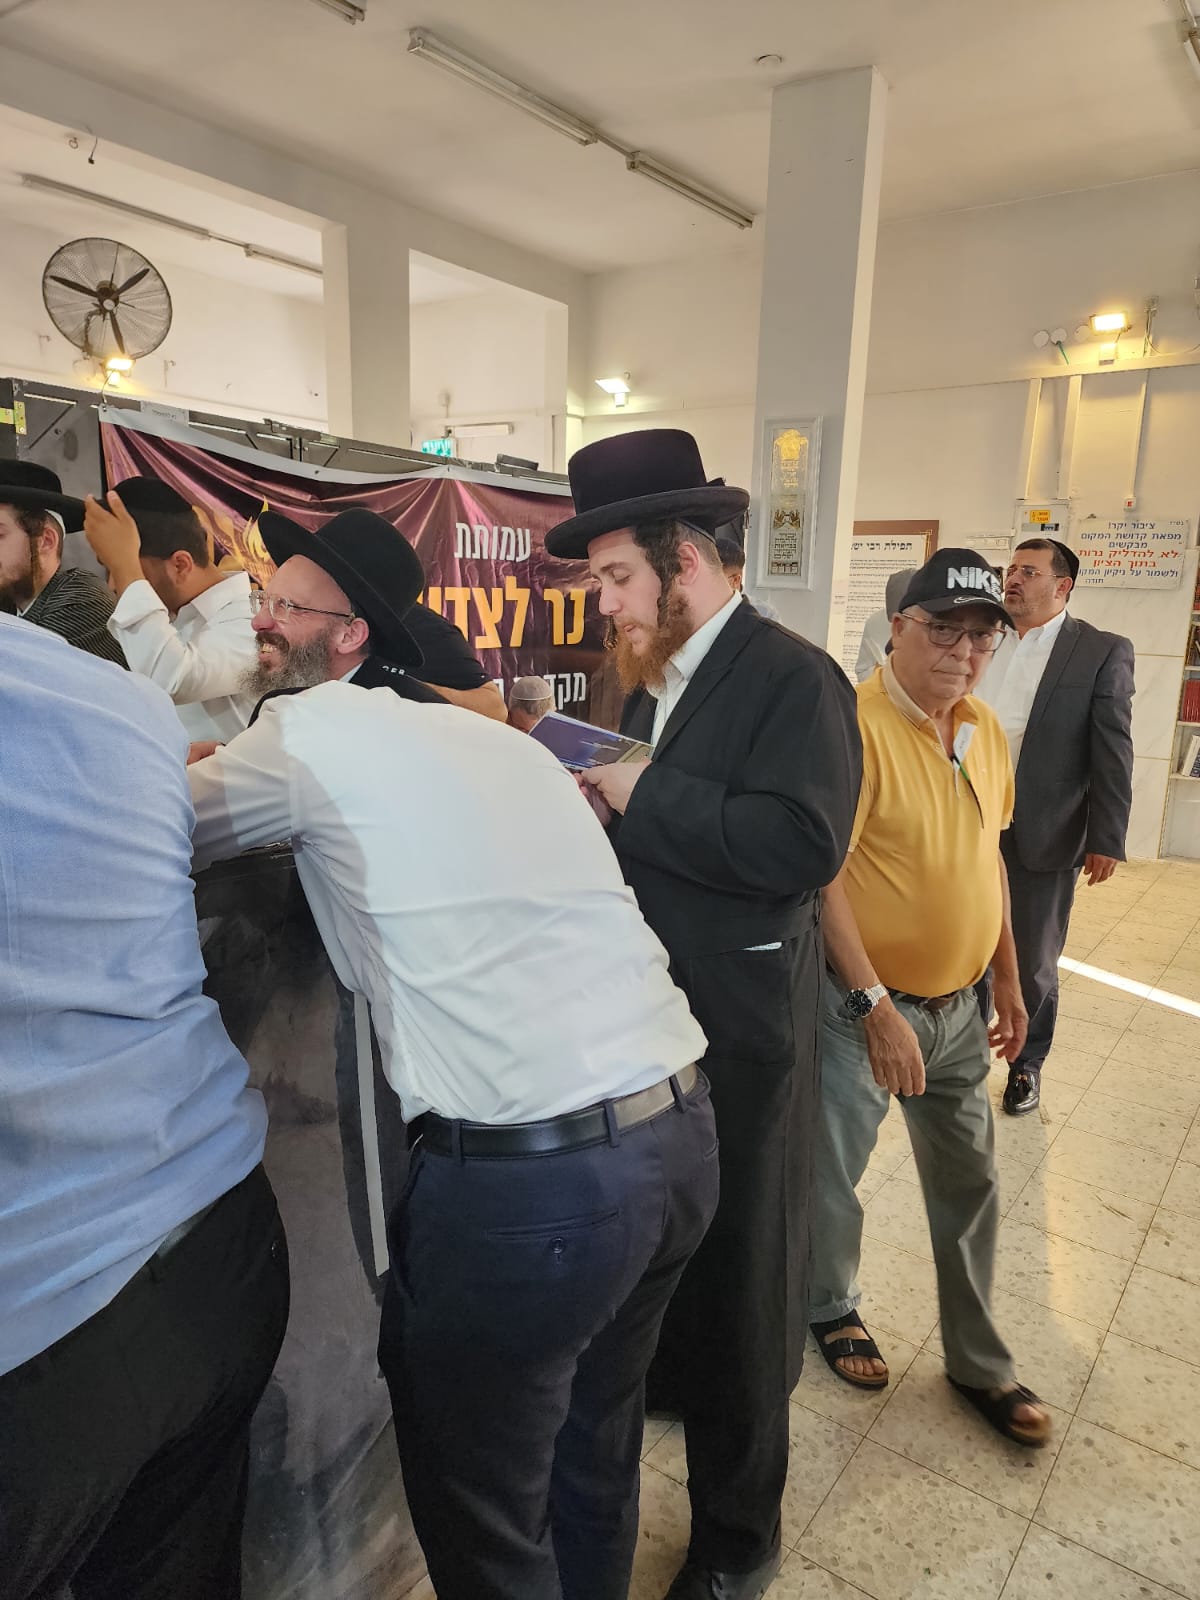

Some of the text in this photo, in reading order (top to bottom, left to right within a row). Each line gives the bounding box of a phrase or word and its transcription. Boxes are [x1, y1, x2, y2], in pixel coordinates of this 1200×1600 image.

[1108, 521, 1156, 531] ציבור יקר!
[1080, 532, 1182, 541] מפאת קדושת המקום
[453, 522, 531, 563] עמותת
[850, 539, 912, 551] תפילת רבי יש
[1108, 541, 1148, 550] מבקשים
[1078, 549, 1179, 559] לא להדליק נרות
[1093, 559, 1156, 569] בתוך הציון
[1078, 568, 1178, 578] ולשמור על ניקיון המקו
[416, 575, 587, 649] נר לצדי
